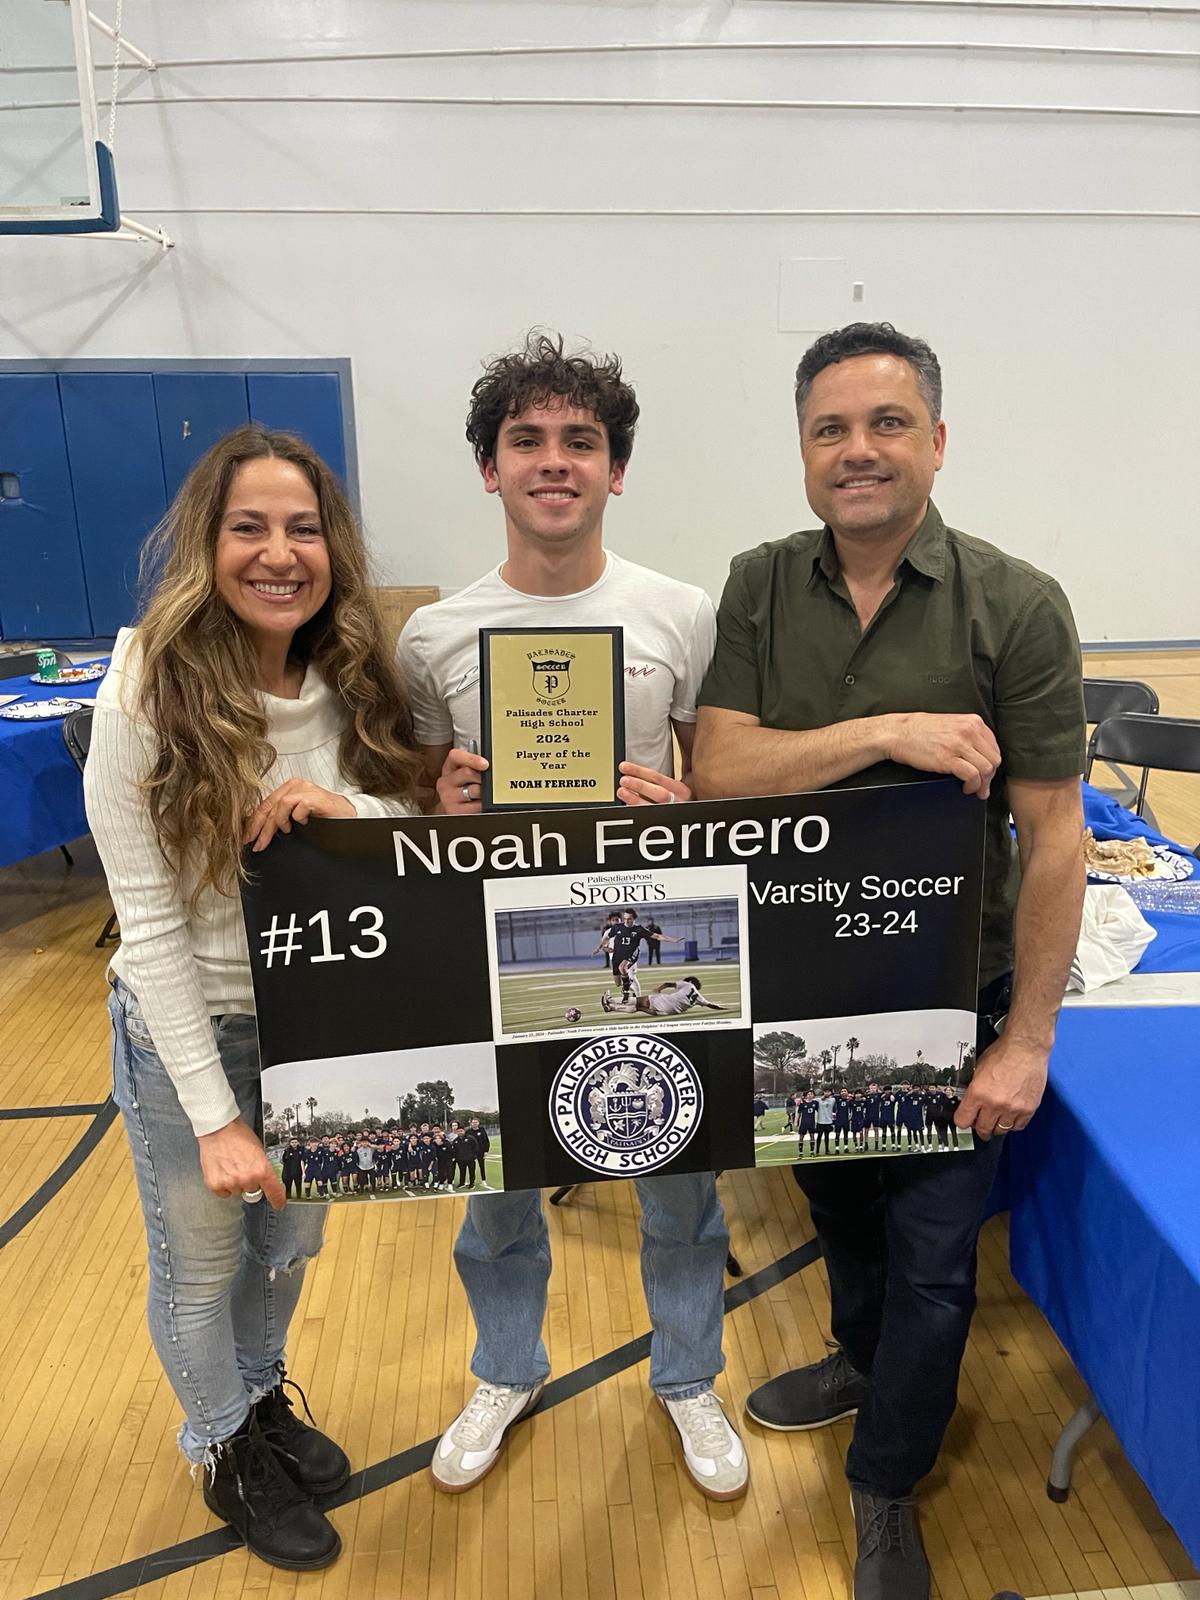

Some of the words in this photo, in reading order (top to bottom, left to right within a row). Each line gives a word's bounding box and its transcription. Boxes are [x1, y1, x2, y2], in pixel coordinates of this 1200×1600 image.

[545, 675, 558, 693] P
[506, 709, 553, 717] Palisades
[520, 720, 545, 729] High
[548, 719, 584, 727] School
[536, 734, 570, 743] 2024
[516, 751, 552, 760] Player
[556, 750, 568, 758] of
[571, 750, 591, 758] the
[540, 762, 566, 770] Year
[510, 780, 542, 789] NOAH
[545, 779, 597, 788] FERRERO
[392, 823, 567, 877] Noah
[595, 815, 831, 865] Ferrero
[587, 873, 652, 883] Palisadian-Post
[570, 882, 666, 905] SPORTS
[749, 877, 851, 908] Varsity
[860, 874, 964, 900] Soccer
[834, 909, 918, 938] 23-24
[260, 905, 387, 968] #13
[621, 937, 631, 945] 13
[557, 1038, 629, 1116] PALISADES
[635, 1040, 696, 1108] CHARTER
[566, 1128, 609, 1165] HIGH
[619, 1125, 689, 1167] SCHOOL
